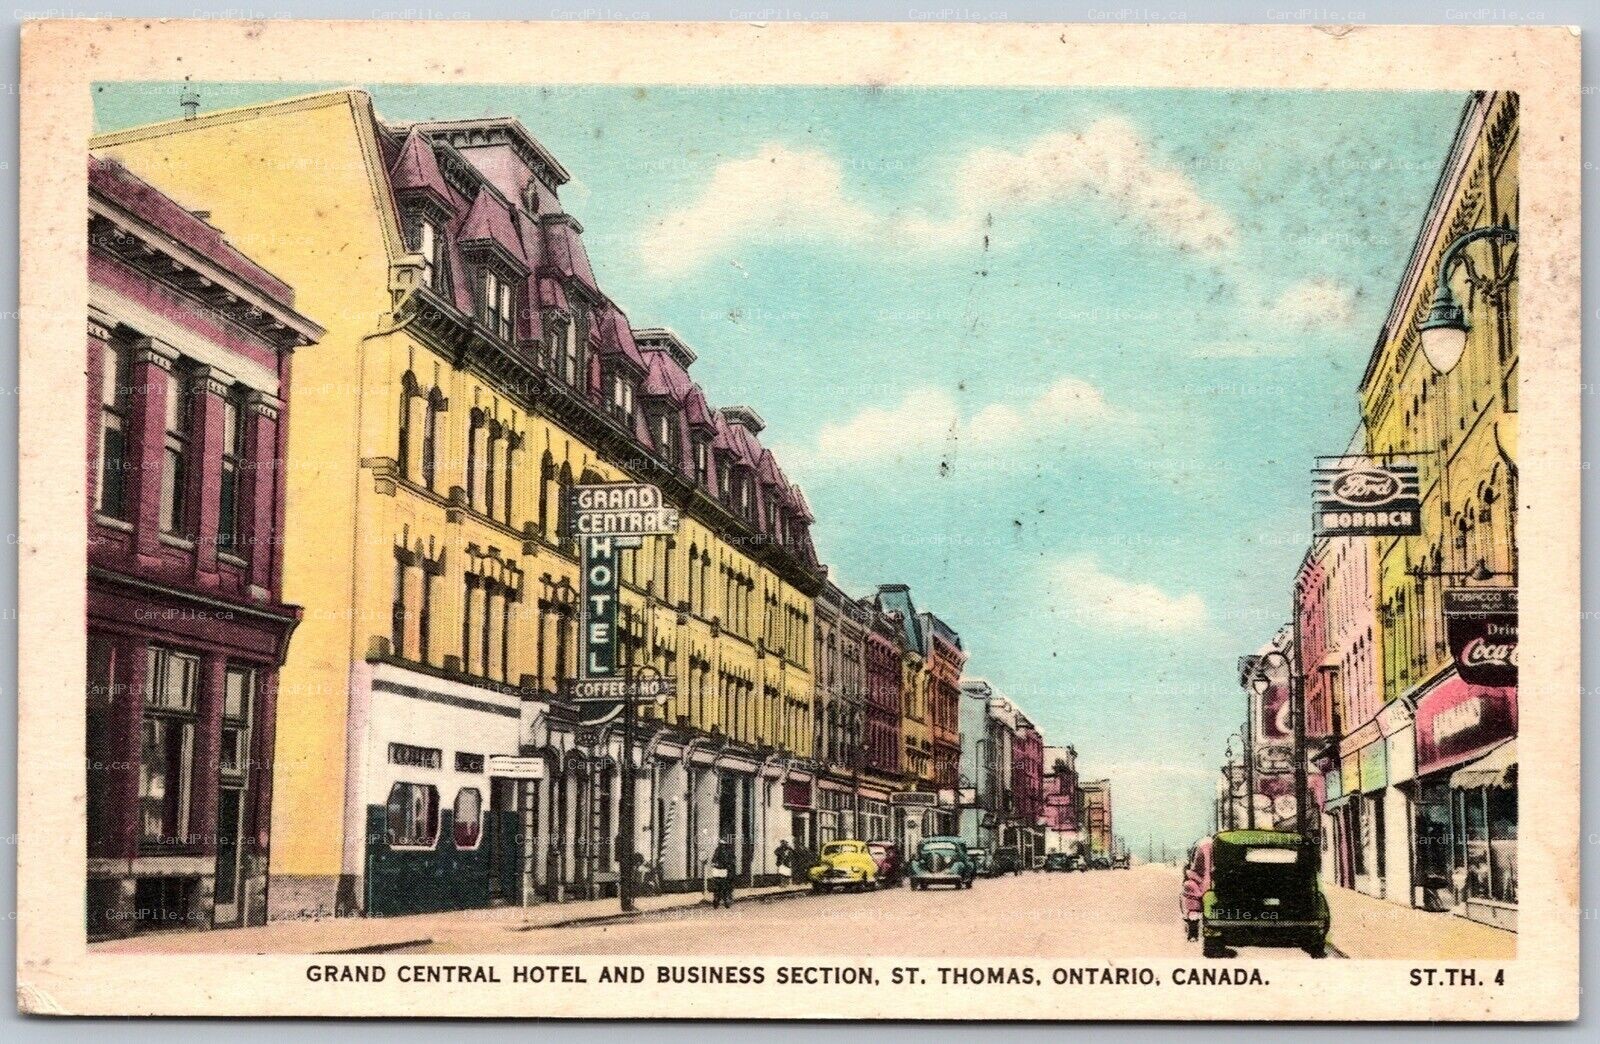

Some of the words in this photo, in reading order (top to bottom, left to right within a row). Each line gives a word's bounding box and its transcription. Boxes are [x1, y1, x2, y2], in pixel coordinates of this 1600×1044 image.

[1337, 474, 1394, 499] Ford
[579, 488, 654, 508] GRAND
[578, 512, 670, 533] CENTRAL
[1322, 510, 1413, 529] MONARCH
[590, 536, 611, 673] HOTEL
[575, 682, 626, 697] COFFEE
[307, 966, 385, 982] GRAND
[398, 966, 500, 982] CENTRAL
[514, 966, 586, 983] HOTEL
[599, 967, 644, 983] AND
[658, 967, 764, 983] BUSINESS
[777, 967, 879, 985] SECTION,
[892, 968, 925, 984] ST.
[938, 968, 1040, 985] THOMAS,
[1173, 969, 1269, 985] CANADA.
[1410, 969, 1483, 986] ST.TH.
[1495, 969, 1505, 985] 4
